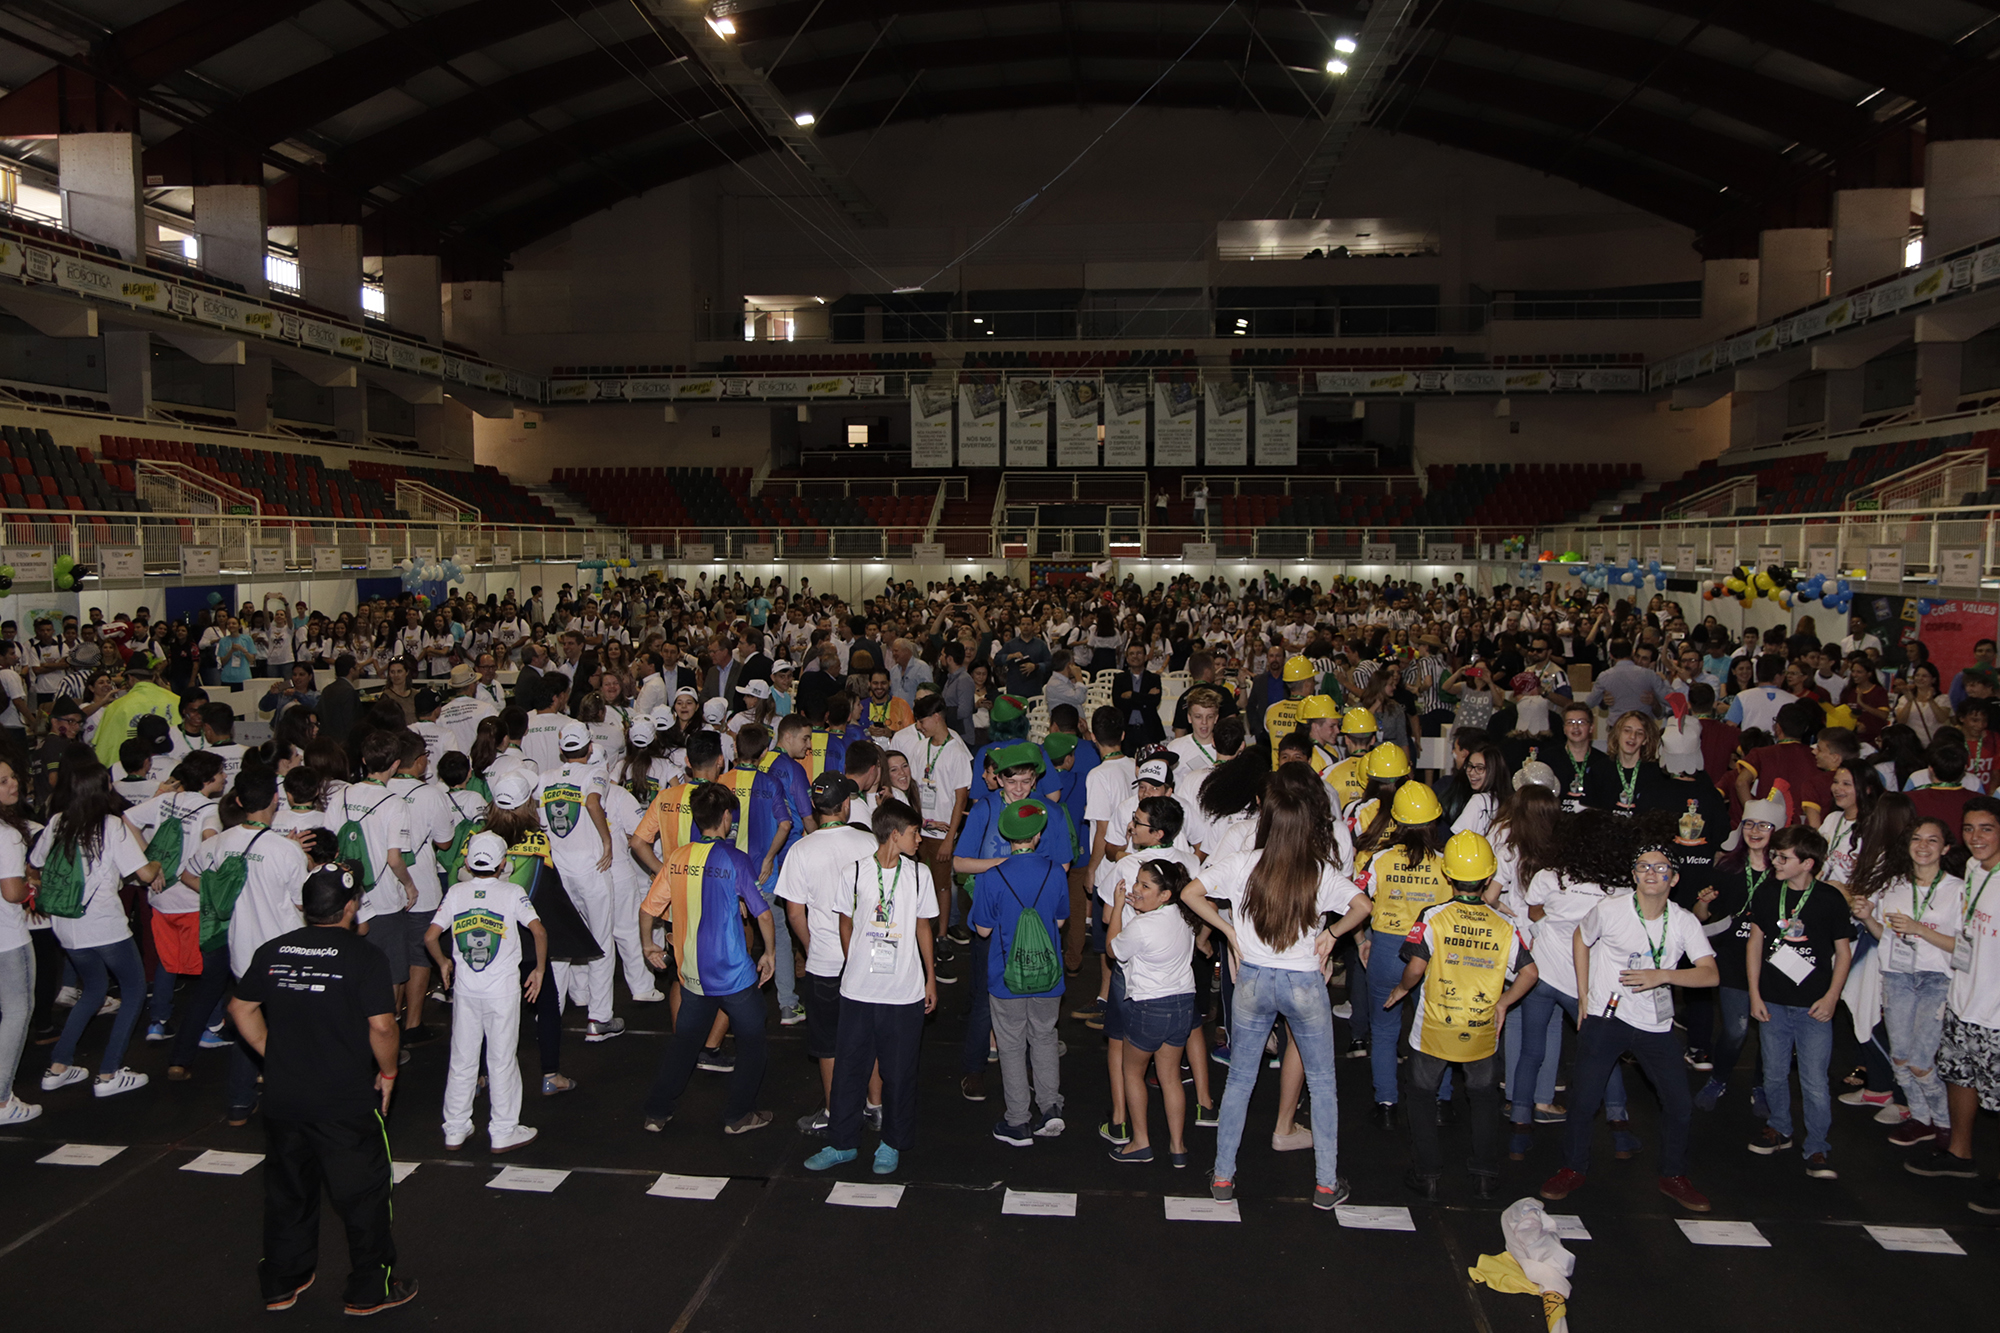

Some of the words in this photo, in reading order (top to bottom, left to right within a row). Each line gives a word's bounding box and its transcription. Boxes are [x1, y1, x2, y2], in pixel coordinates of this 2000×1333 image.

[1930, 603, 1957, 616] CORE
[1962, 602, 1997, 616] VALUES
[1140, 766, 1161, 776] adidas
[1686, 856, 1712, 865] Victor
[684, 864, 699, 876] RISE
[714, 867, 731, 879] SUN
[1386, 873, 1439, 885] ROBÓTICA
[455, 917, 478, 930] AGRO
[1453, 924, 1493, 937] EQUIPE
[1444, 937, 1500, 951] ROBÓTICA
[279, 945, 339, 957] COORDENAÇÃO
[1445, 987, 1456, 996] LS
